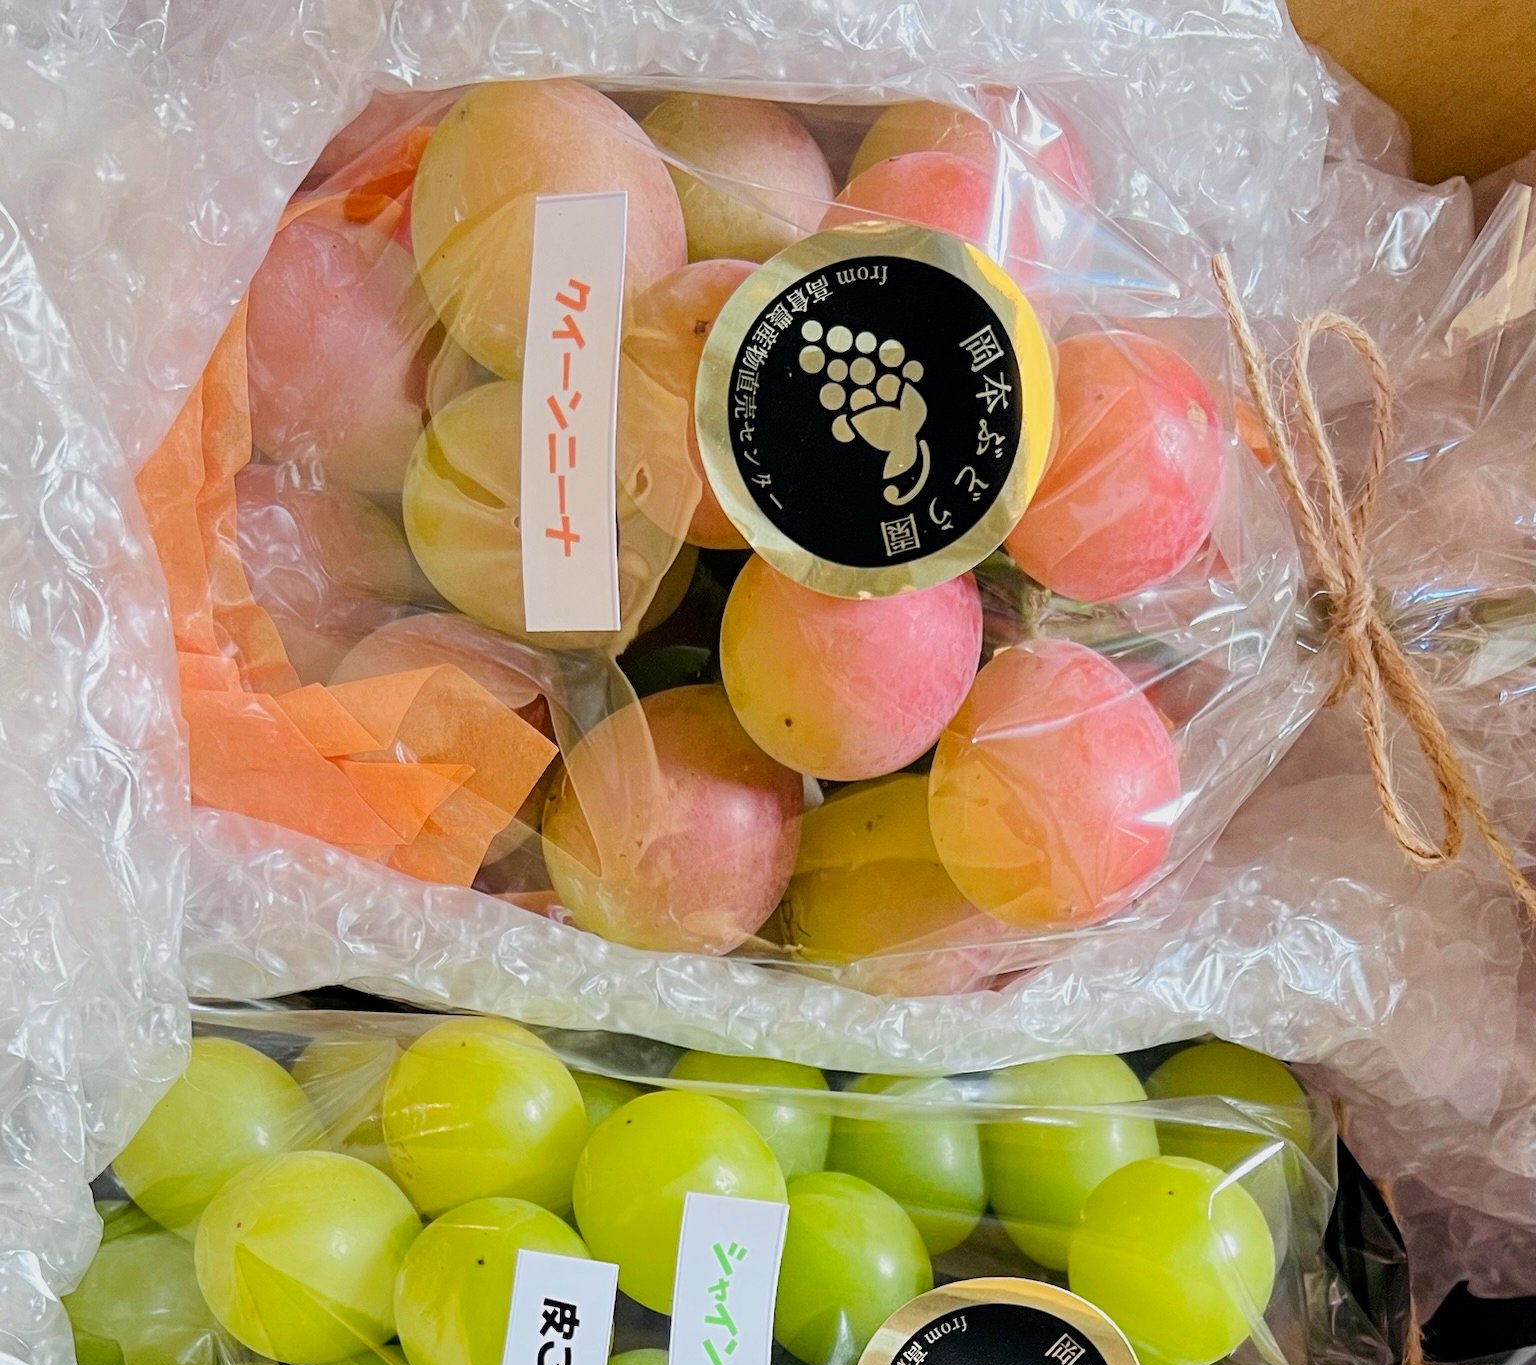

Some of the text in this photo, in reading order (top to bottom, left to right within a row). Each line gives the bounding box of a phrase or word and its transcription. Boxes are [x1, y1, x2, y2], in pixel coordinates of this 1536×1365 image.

[544, 278, 592, 559] クイーンニーナ
[734, 265, 889, 510] from 高倉農産物直売センター
[879, 324, 1012, 557] 岡本ぶどう園
[924, 1314, 969, 1345] from
